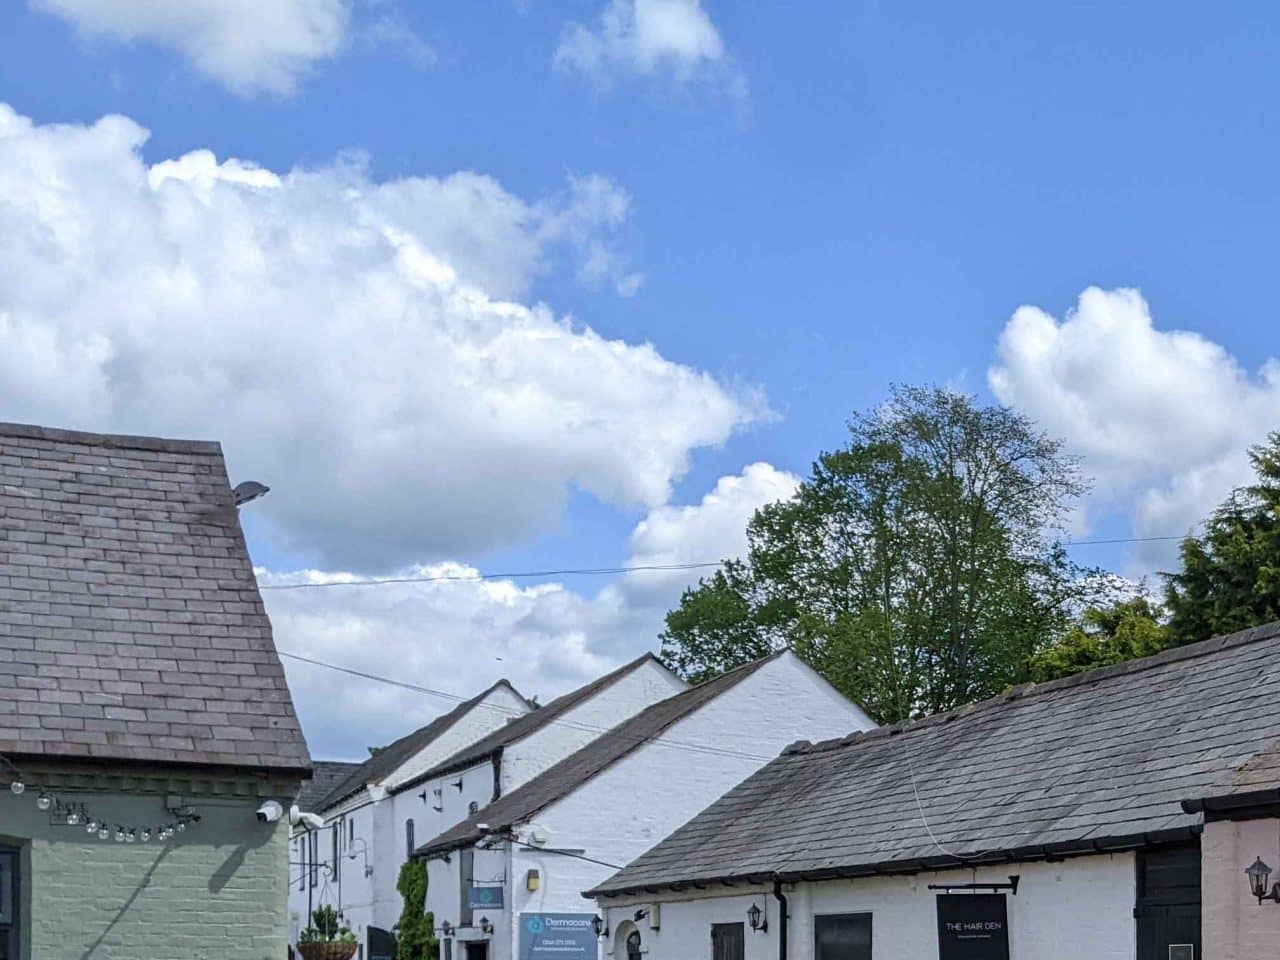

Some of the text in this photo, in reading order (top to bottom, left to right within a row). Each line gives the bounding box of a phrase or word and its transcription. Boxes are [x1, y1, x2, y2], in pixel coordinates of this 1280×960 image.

[946, 921, 1001, 931] THE HAIR DEN
